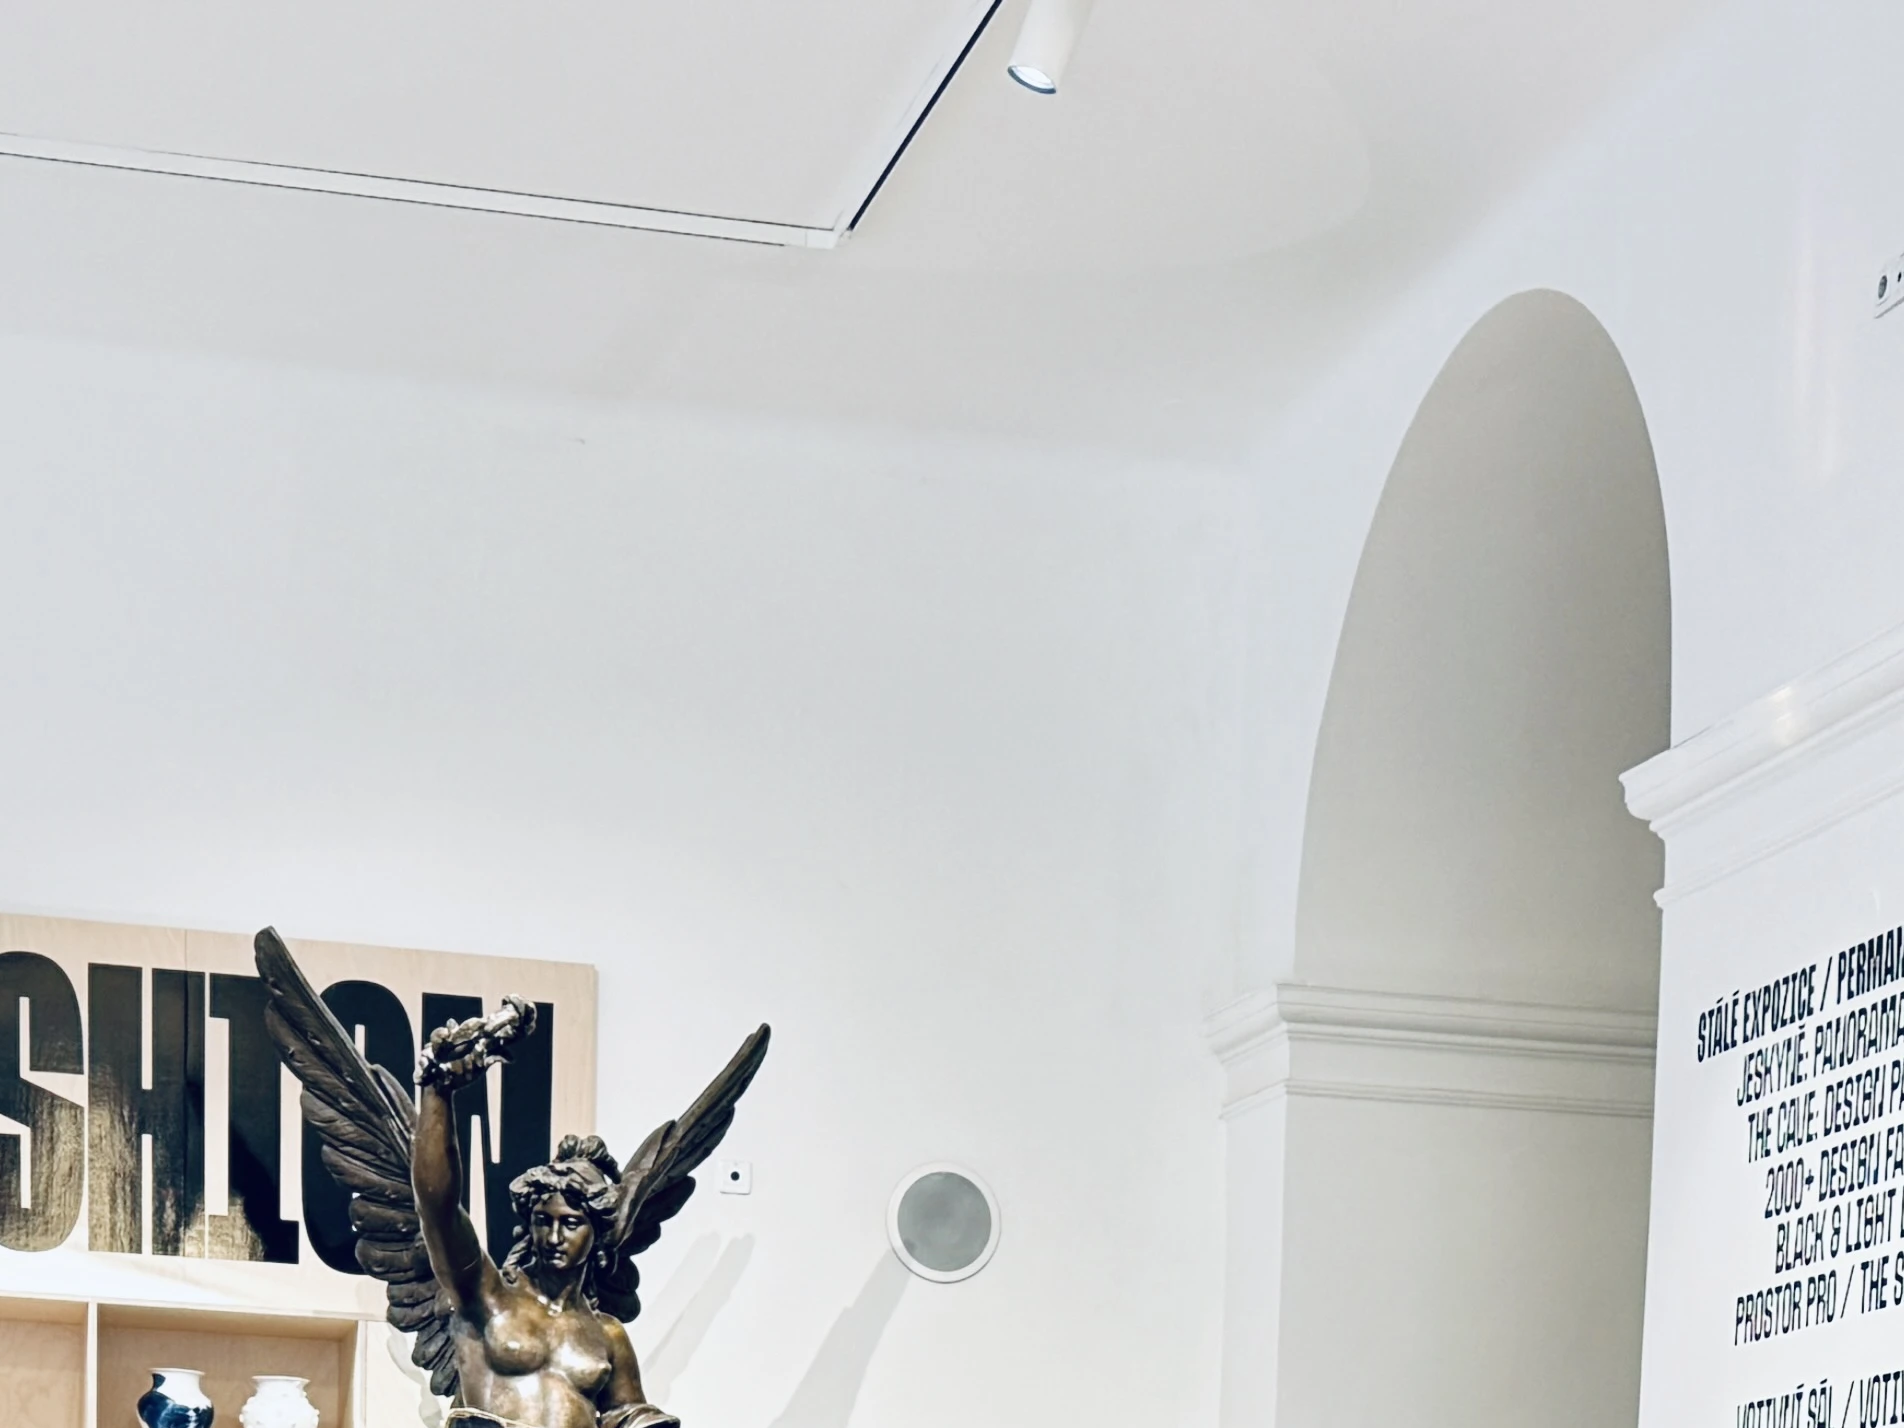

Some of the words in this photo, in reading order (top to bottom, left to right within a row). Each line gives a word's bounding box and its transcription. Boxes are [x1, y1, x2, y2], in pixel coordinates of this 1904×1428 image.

[1697, 990, 1739, 1063] STÁLÉ
[1742, 964, 1817, 1043] EXPOZICE
[1820, 956, 1833, 1012] /
[1748, 1107, 1774, 1163] THE
[1823, 1064, 1886, 1137] DESIGN
[1764, 1157, 1814, 1219] 2000+
[1818, 1131, 1881, 1202] DESIGN
[1775, 1209, 1827, 1274] BLACK
[1845, 1188, 1896, 1254] LIGHT
[1734, 1280, 1802, 1346] PROSTOR
[1805, 1269, 1837, 1327] PRO
[1840, 1264, 1855, 1319] /
[1860, 1255, 1889, 1314] THE
